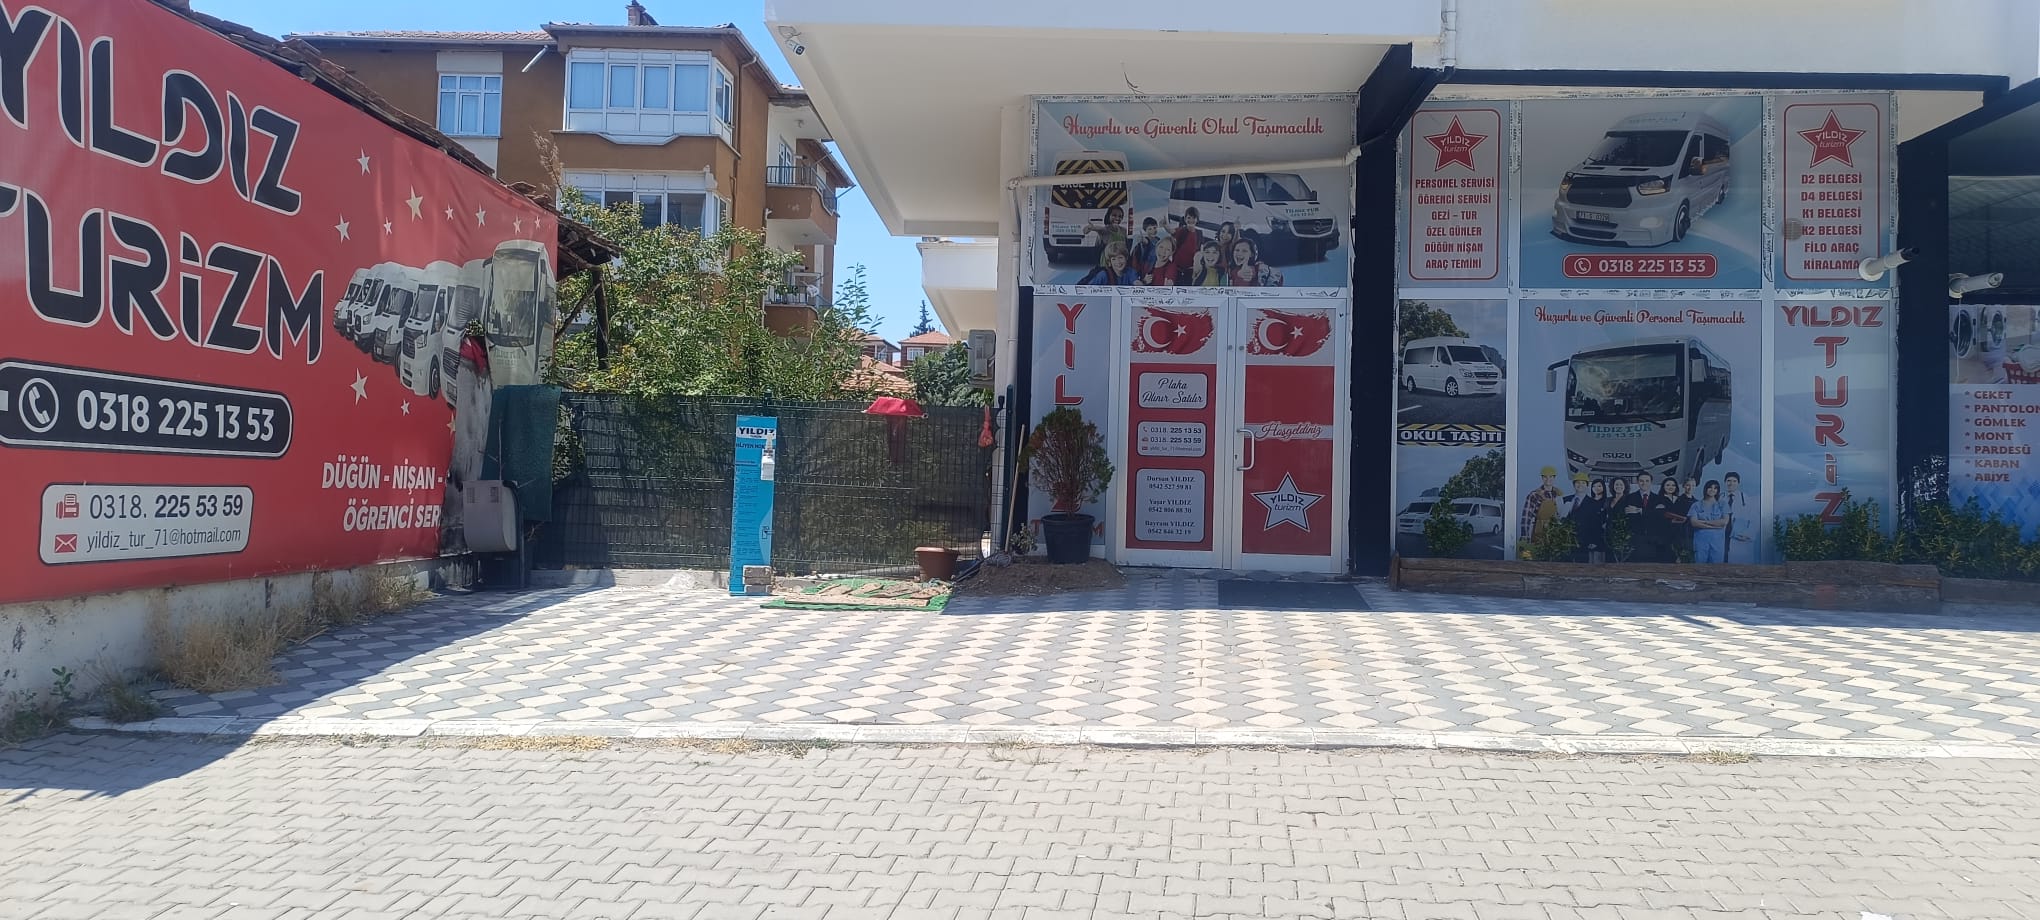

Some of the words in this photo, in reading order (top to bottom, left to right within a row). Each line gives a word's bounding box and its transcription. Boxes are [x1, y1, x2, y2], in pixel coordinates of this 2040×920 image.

[0, 3, 302, 216] YILDIZ
[1063, 114, 1121, 138] Huzurlu
[1125, 124, 1140, 136] ve
[1144, 118, 1198, 139] Güvenli
[1202, 117, 1239, 135] Okul
[1243, 117, 1324, 138] Taşımacılık
[1440, 135, 1471, 147] YILDIZ
[1815, 130, 1848, 142] YILDIZ
[1444, 145, 1468, 153] turizm
[1415, 179, 1458, 188] PERSONEL
[1461, 177, 1495, 188] SERVİSİ
[1801, 174, 1814, 184] D2
[1818, 173, 1862, 184] BELGESİ
[1418, 194, 1454, 205] ÖĞRENCİ
[1457, 193, 1491, 204] SERVİSİ
[1801, 191, 1815, 201] D4
[1818, 189, 1862, 201] BELGESİ
[1431, 209, 1450, 220] GEZİ
[1461, 210, 1477, 220] TUR
[1802, 208, 1814, 218] K1
[1817, 206, 1861, 218] BELGESİ
[1426, 226, 1446, 237] ÖZEL
[1449, 226, 1482, 237] GÜNLER
[1802, 225, 1815, 236] K2
[1818, 223, 1862, 236] BELGESİ
[1424, 241, 1454, 253] DÜĞÜN
[1456, 241, 1483, 254] NİŞAN
[1804, 241, 1827, 253] FİLO
[1830, 243, 1860, 255] ARAÇ
[1425, 259, 1449, 270] ARAÇ
[1451, 258, 1482, 269] TEMİNİ
[1598, 259, 1634, 273] 0318
[1637, 259, 1665, 273] 225
[1668, 259, 1684, 273] 13
[1688, 259, 1706, 273] 53
[1803, 258, 1860, 270] KİRALAMA
[1534, 306, 1578, 326] Huzurlu
[1580, 314, 1592, 323] ve
[1594, 308, 1634, 326] Güvenli
[1636, 309, 1684, 324] Personel
[1685, 308, 1746, 326] Taşımacılık
[1781, 305, 1884, 328] YILDIZ
[1157, 377, 1188, 390] Plaka
[1142, 390, 1169, 403] Alınır
[1974, 391, 2013, 400] CEKET
[77, 389, 150, 433] 0318
[158, 398, 208, 438] 225
[215, 404, 241, 439] 13
[246, 407, 275, 442] 53
[1974, 415, 2027, 427] GÖMLEK
[1400, 430, 1445, 441] OKUL
[1450, 431, 1502, 443] TAŞITI
[1974, 431, 2014, 441] MONT
[1974, 444, 2032, 455] PARDESÜ
[1974, 459, 2020, 469] KABAN
[321, 454, 381, 489] DÜĞÜN
[392, 458, 436, 495] NİŞAN
[1170, 475, 1196, 483] YILDIZ
[1270, 493, 1304, 506] YILDIZ
[90, 494, 147, 520] 0318.
[154, 494, 190, 519] 225
[195, 494, 218, 518] 53
[222, 494, 244, 517] 59
[1274, 503, 1302, 511] turizm
[343, 498, 414, 532] ÖĞRENCİ
[86, 527, 241, 553] yildiz_tur_71@hotmail.com
